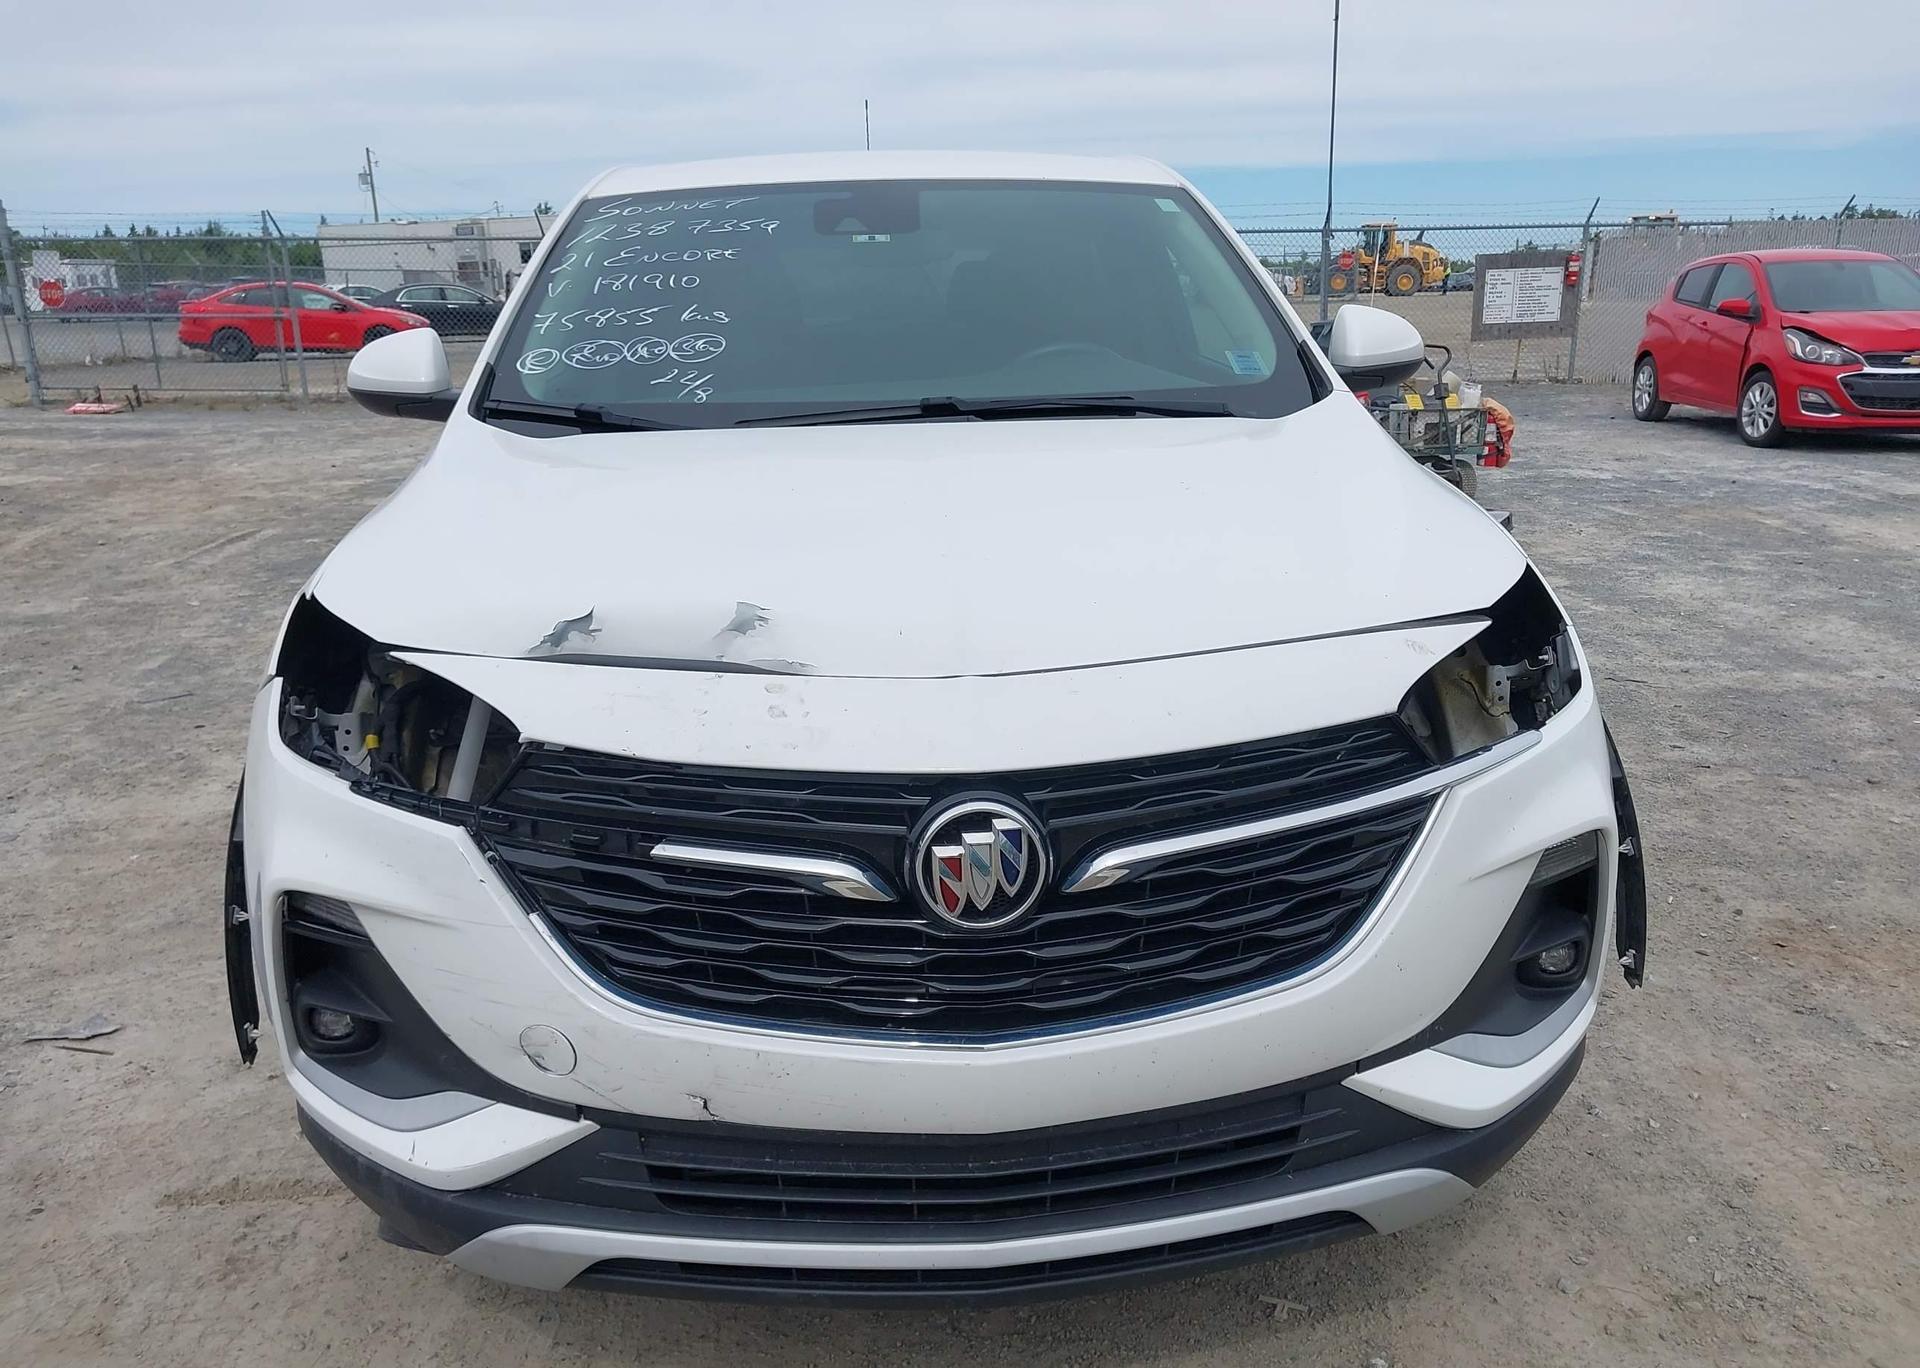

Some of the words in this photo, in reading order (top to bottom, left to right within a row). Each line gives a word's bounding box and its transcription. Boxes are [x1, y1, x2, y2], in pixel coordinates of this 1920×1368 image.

[584, 197, 761, 223] SONNET
[41, 289, 63, 300] STOP
[593, 273, 702, 295] 181910
